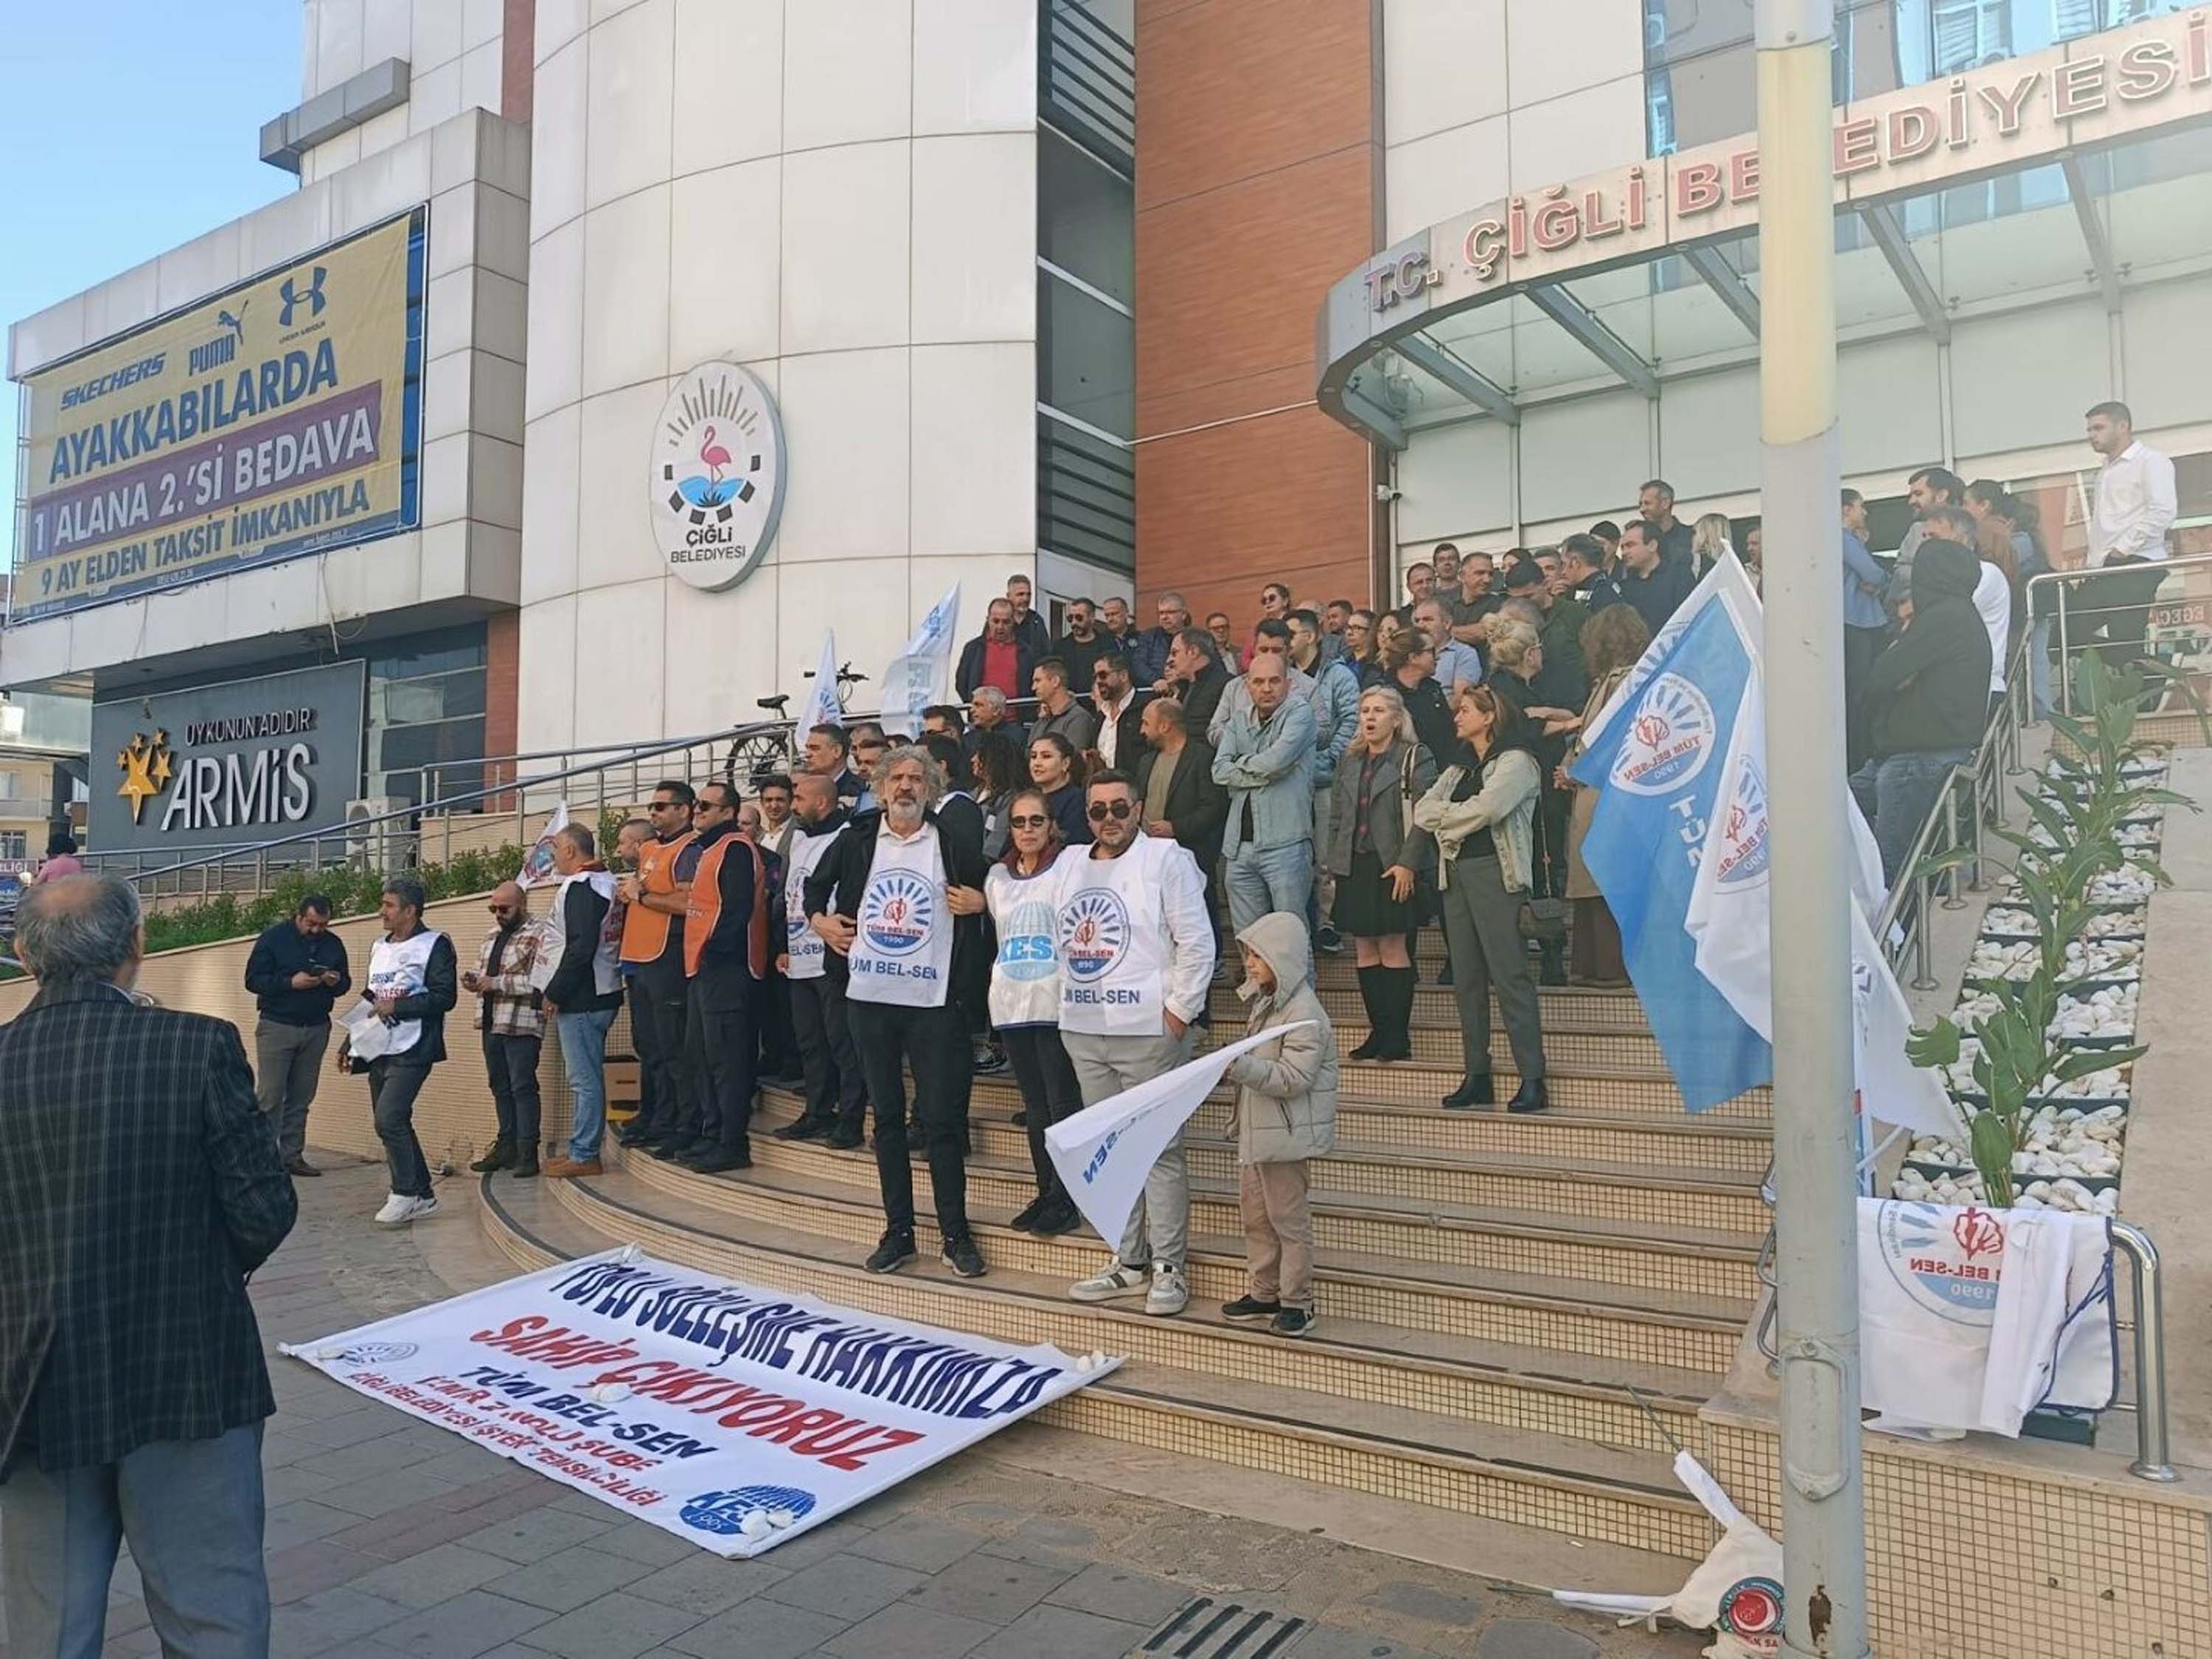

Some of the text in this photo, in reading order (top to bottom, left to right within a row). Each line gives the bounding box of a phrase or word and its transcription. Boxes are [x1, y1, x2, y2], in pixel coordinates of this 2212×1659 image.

[1363, 12, 2211, 313] T.C. ÇİĞLİ BEEDİYESİ
[60, 352, 167, 411] SKECHERS
[189, 333, 235, 376] PUMA
[49, 338, 338, 484] AYAKKABILARDA
[35, 514, 44, 552] 1
[55, 484, 150, 546] ALANA
[234, 407, 375, 495] BEDAVA
[42, 566, 52, 595] 9
[57, 559, 83, 592] AY
[86, 541, 147, 585] ELDEN
[153, 515, 225, 568] TAKSİT
[231, 478, 370, 548] İMKANIYLA
[686, 524, 733, 546] ÇİĞLİ
[185, 716, 257, 747] UYKUNUN
[160, 742, 316, 832] ARMİS
[1074, 990, 1141, 1004] BEL-SEN
[549, 1263, 674, 1319] TOPLU
[796, 1326, 1064, 1419] HAKKIMIZA
[458, 1366, 720, 1458] TÜM BEL-SEN
[470, 1315, 927, 1470] SAHİP ÇIKIYORUZ
